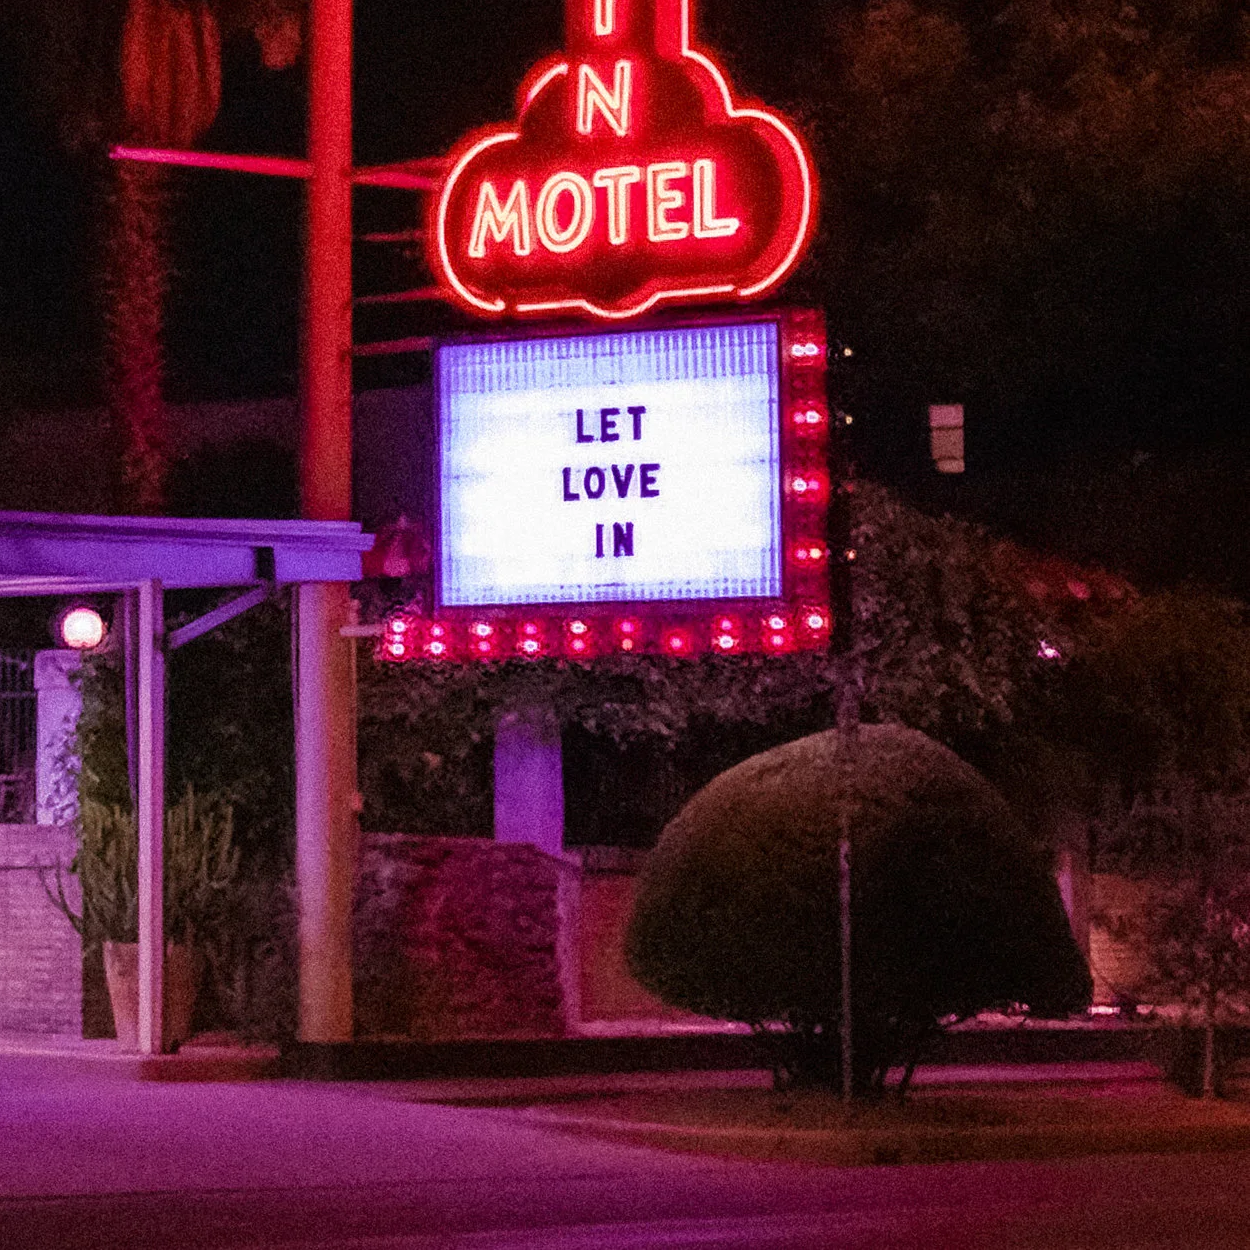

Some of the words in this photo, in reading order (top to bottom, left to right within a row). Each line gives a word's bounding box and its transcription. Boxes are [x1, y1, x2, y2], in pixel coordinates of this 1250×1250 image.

[468, 159, 740, 258] MOTEL
[576, 406, 647, 443] LET
[562, 463, 661, 501] LOVE
[595, 521, 634, 558] IN
